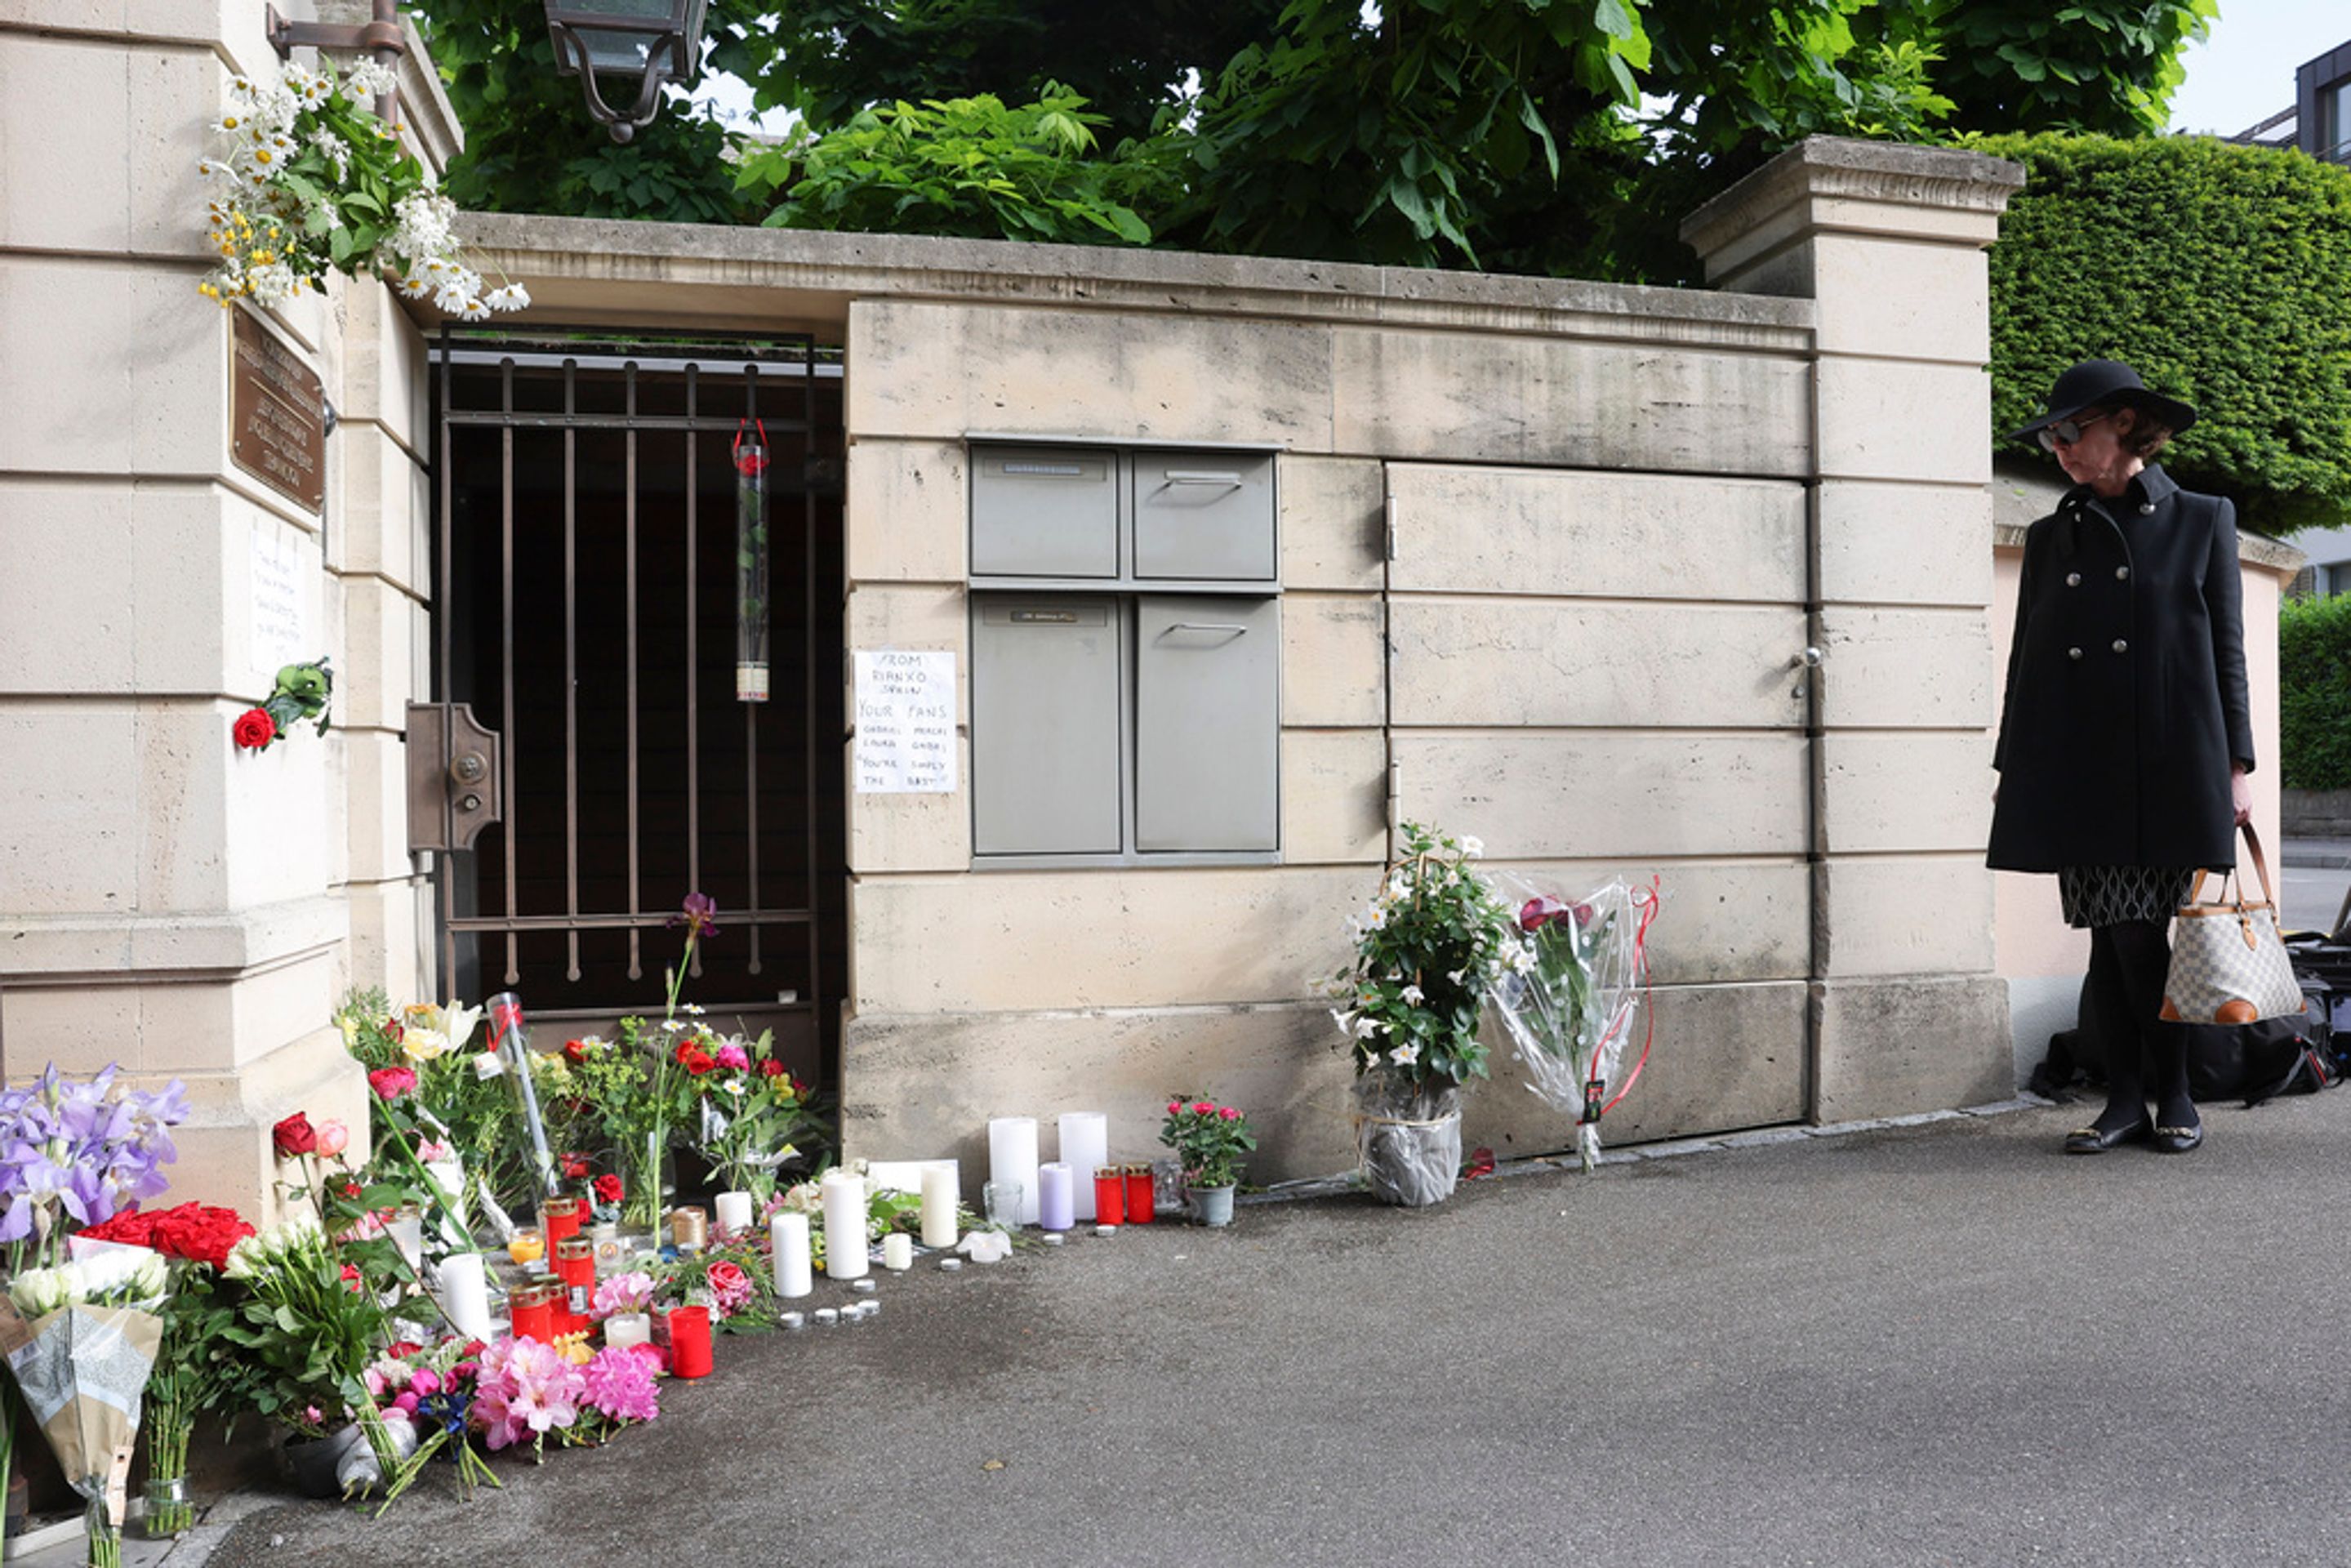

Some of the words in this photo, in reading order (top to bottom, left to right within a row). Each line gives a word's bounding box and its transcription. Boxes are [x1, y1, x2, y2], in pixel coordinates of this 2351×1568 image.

[879, 654, 921, 666] FROM
[859, 698, 893, 717] YOUR
[908, 705, 946, 719] FANS
[864, 776, 884, 786] THE
